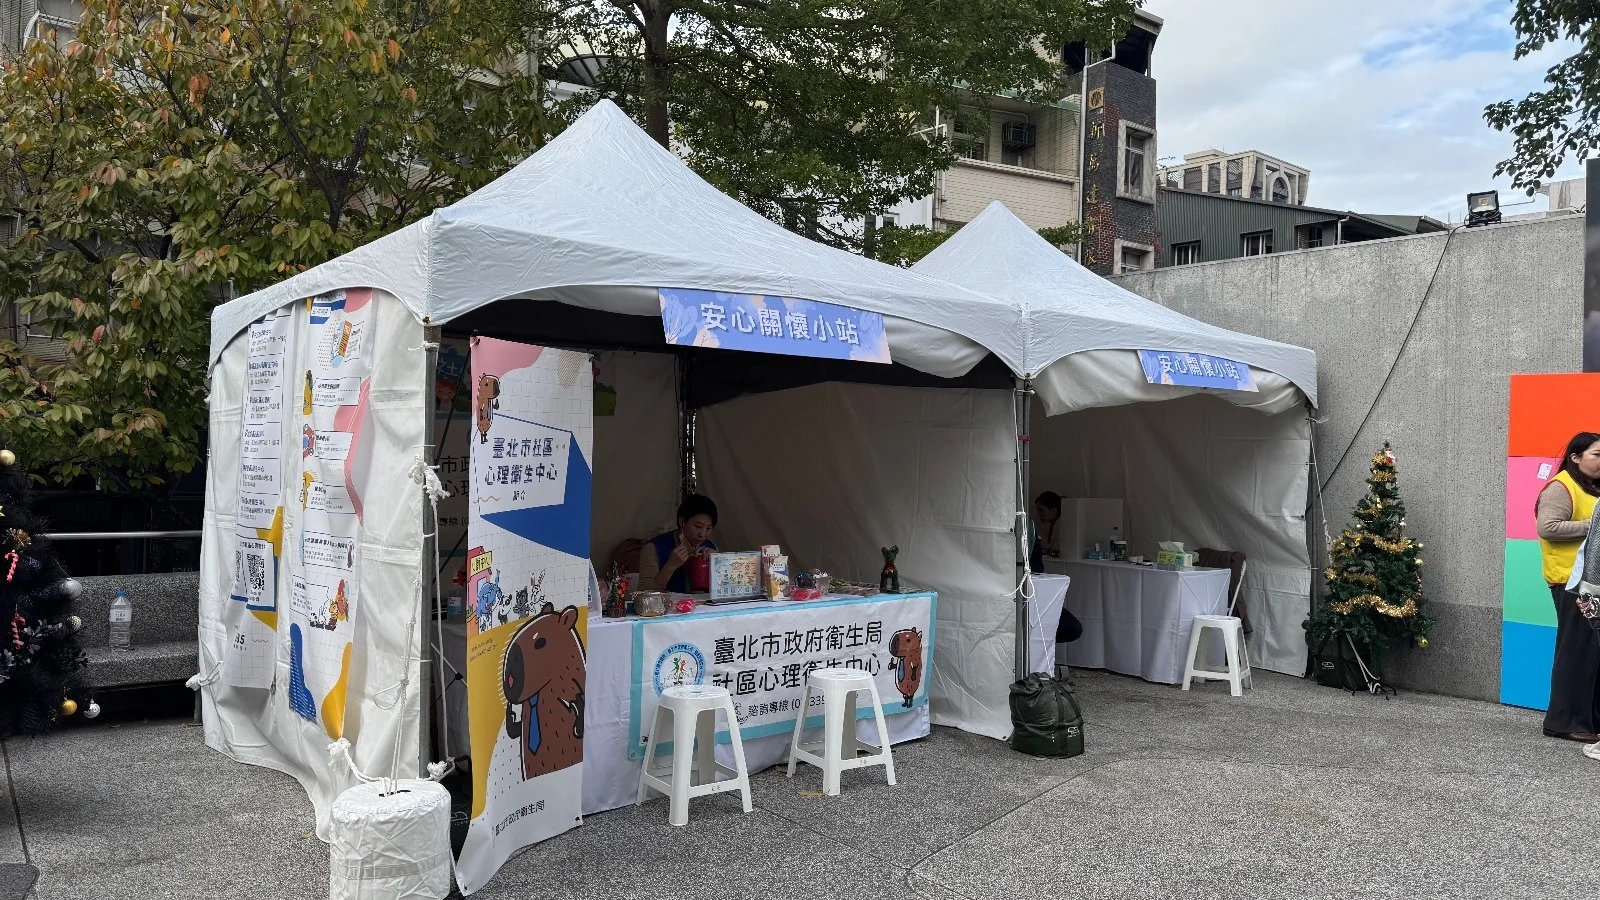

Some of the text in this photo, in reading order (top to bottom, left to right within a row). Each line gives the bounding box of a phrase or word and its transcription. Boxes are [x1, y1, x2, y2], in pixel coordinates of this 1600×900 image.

[700, 301, 861, 345] 安心關懷小站
[1157, 354, 1241, 380] 安心關懷小站
[492, 437, 554, 459] 臺北市社區
[484, 463, 558, 486] 心理衛生中心
[713, 620, 883, 666] 臺北市政府衛生局
